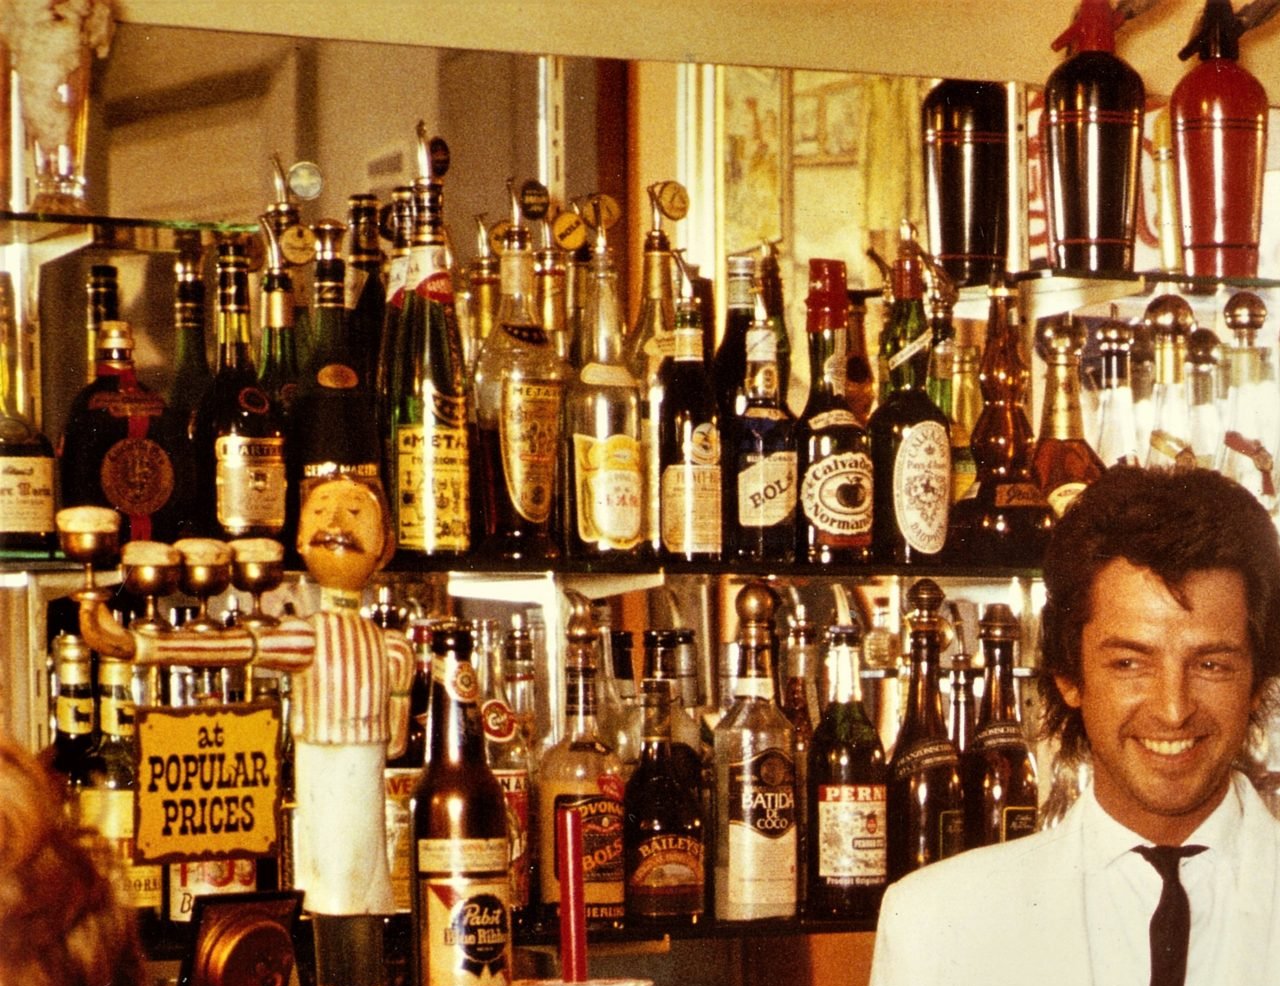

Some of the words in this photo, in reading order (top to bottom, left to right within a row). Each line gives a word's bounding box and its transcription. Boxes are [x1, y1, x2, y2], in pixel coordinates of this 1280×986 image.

[512, 387, 560, 397] META
[411, 433, 466, 449] META
[198, 721, 224, 749] at
[147, 751, 271, 793] POPULAR
[162, 795, 255, 837] PRICES
[756, 818, 789, 830] COCO
[638, 836, 701, 858] BAILEYS
[463, 904, 503, 927] Pabst
